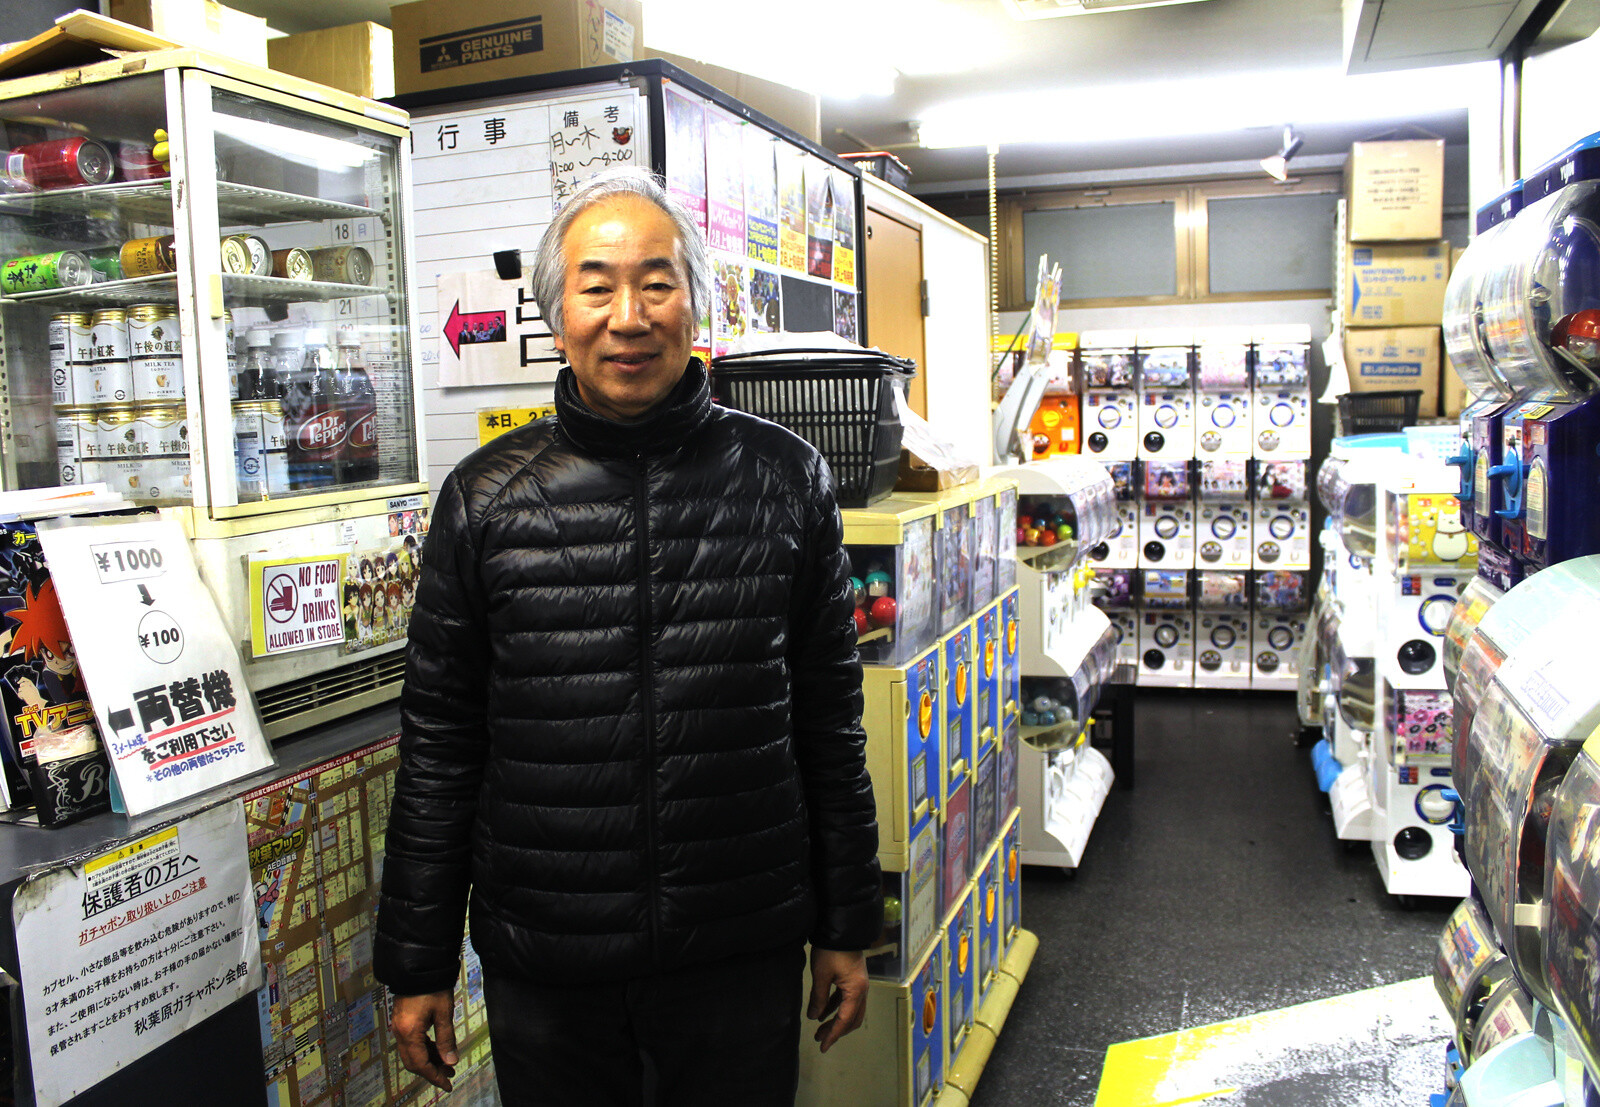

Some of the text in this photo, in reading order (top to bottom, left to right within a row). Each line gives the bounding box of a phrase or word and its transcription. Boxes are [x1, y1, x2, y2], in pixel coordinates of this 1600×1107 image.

[461, 28, 533, 52] GENUINE
[461, 44, 514, 64] PARTS
[334, 223, 350, 240] 18
[339, 299, 353, 315] 21
[308, 420, 347, 446] Pepper
[320, 413, 340, 432] Dr
[389, 500, 408, 510] SANYO
[96, 547, 164, 573] ¥1000
[298, 563, 337, 587] NO FOOD
[314, 588, 323, 598] OR
[302, 599, 337, 624] DRINKS
[138, 626, 180, 648] ¥100
[269, 622, 341, 649] ALLOWED IN STORE
[132, 669, 237, 733] 両替機
[141, 722, 236, 765] をご利用下さい
[248, 828, 305, 869] 秋葉マップ
[81, 854, 199, 918] 保護者の方へ
[78, 876, 208, 945] ガチャポン取り扱い上のご注意
[133, 961, 249, 1037] 秋葉原ガチャポン会館
